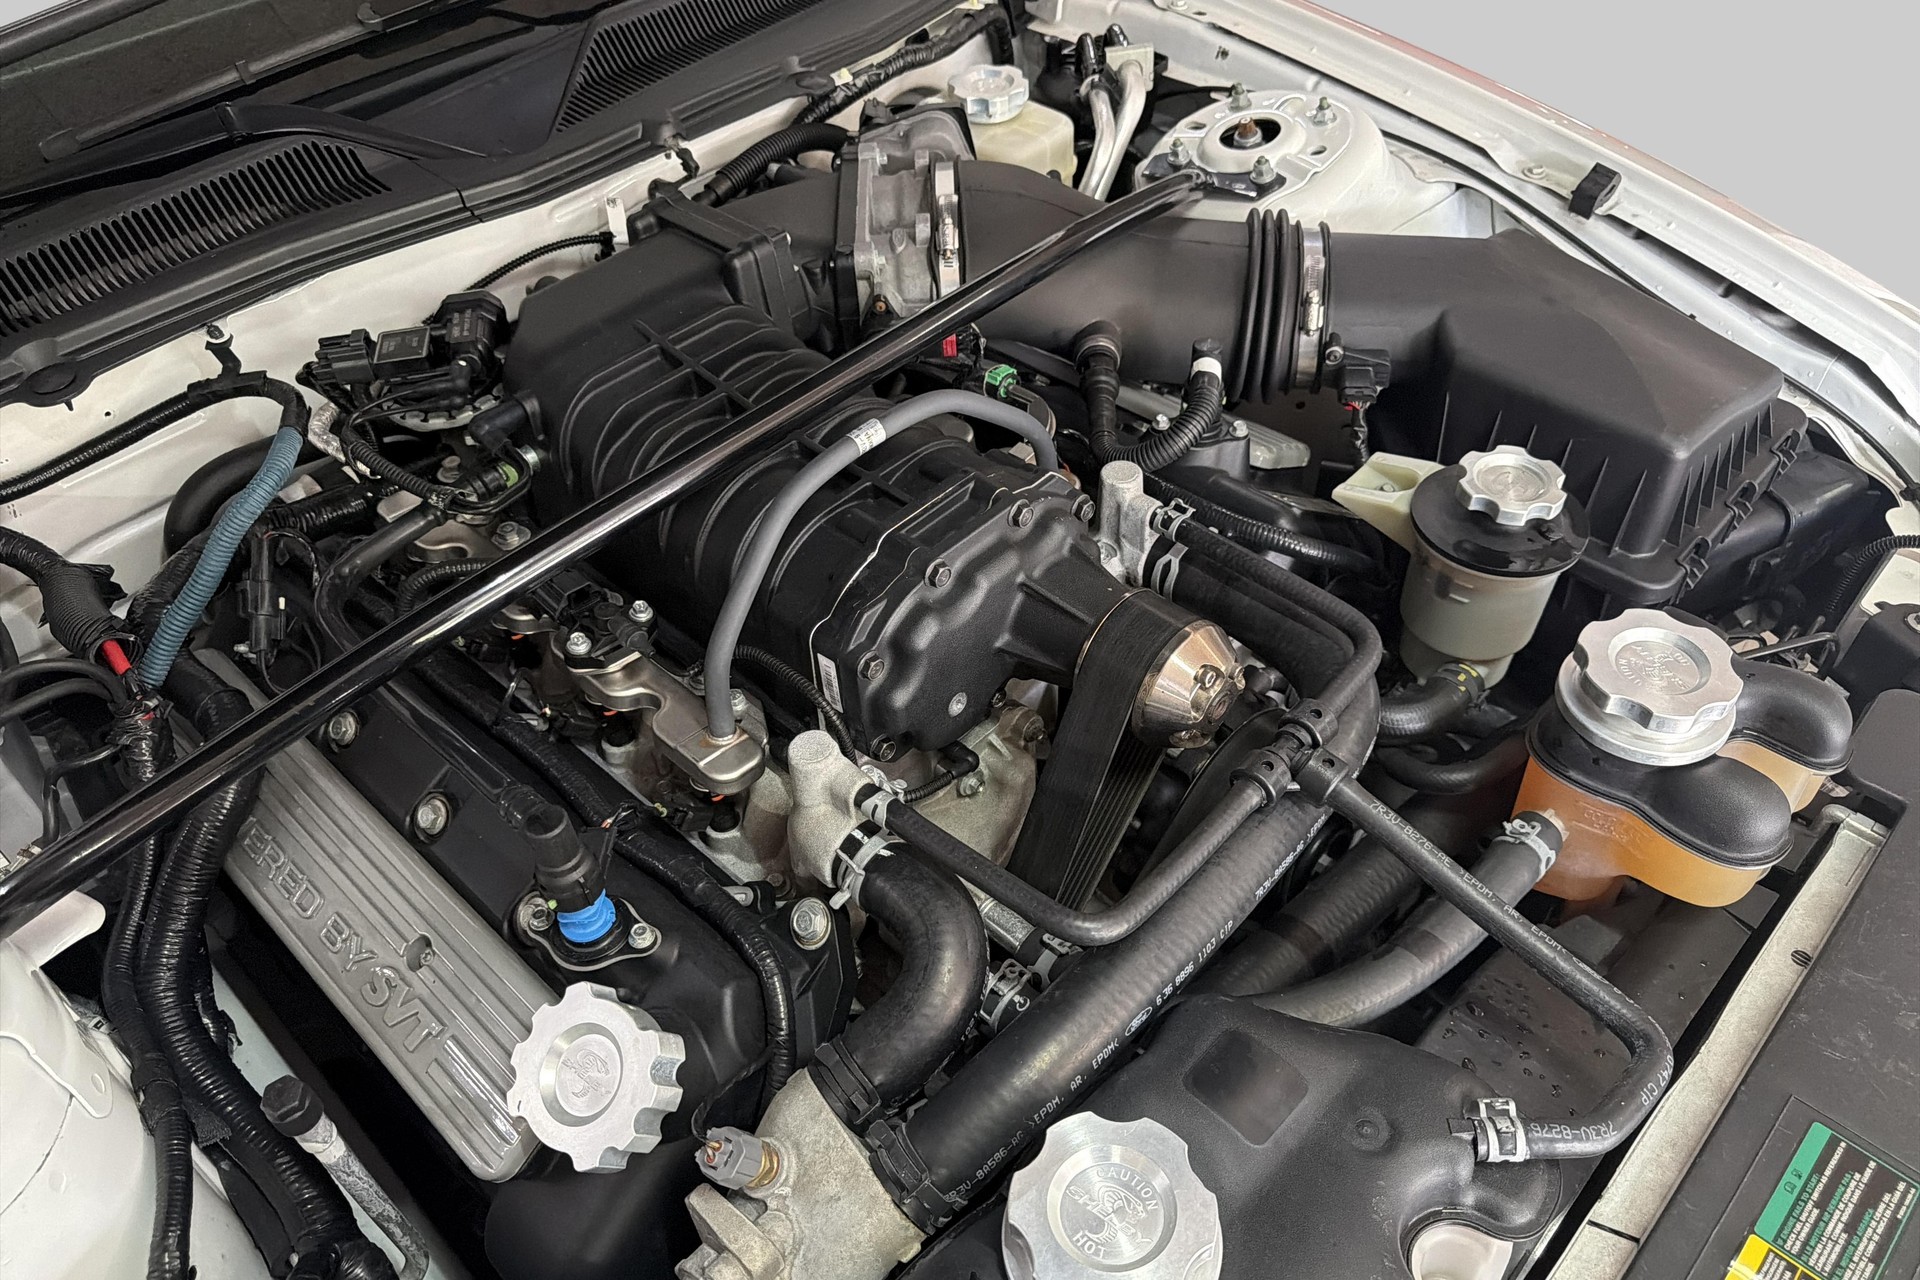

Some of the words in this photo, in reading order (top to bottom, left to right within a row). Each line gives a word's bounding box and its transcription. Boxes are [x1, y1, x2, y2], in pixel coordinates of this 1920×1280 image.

[1198, 937, 1216, 963] 1103
[320, 912, 378, 972] BY
[361, 966, 447, 1052] SVT
[1641, 1082, 1658, 1107] CIP
[1860, 1167, 1872, 1183] GUIDE
[1868, 1160, 1876, 1168] DE
[1096, 1167, 1159, 1210] CAUTION
[1784, 1232, 1797, 1250] CHECK
[1793, 1220, 1803, 1234] FUEL
[1799, 1199, 1815, 1222] SHUTOFF
[1811, 1181, 1824, 1200] SWITCH
[1820, 1175, 1827, 1183] AS
[1824, 1146, 1843, 1176] REFERENCED
[1850, 1188, 1861, 1203] DANS
[1857, 1181, 1864, 1189] LE
[1882, 1191, 1891, 1203] DEL
[1780, 1216, 1795, 1239] ENGINE
[1792, 1200, 1804, 1217] FAILS
[1801, 1191, 1809, 1201] TO
[1819, 1236, 1827, 1244] LA
[1823, 1208, 1841, 1237] COMMANDE
[1837, 1201, 1845, 1210] DE
[1841, 1179, 1857, 1203] COUPURE
[1853, 1171, 1861, 1180] DE
[1864, 1240, 1876, 1257] COMO
[1872, 1233, 1879, 1241] SE
[1897, 1180, 1906, 1191] DEL
[1872, 1201, 1886, 1221] CIERRE
[1809, 1220, 1826, 1247] MOTEUR
[1830, 1221, 1844, 1240] COMME
[1869, 1219, 1877, 1228] DE
[1073, 1230, 1106, 1259] HOT
[1790, 1239, 1802, 1254] YOUR
[1798, 1222, 1811, 1241] OWNER
[1839, 1244, 1855, 1267] MOTOR
[1851, 1235, 1859, 1245] NO
[1852, 1226, 1873, 1262] INTERRUPTOR
[1848, 1261, 1856, 1269] EL
